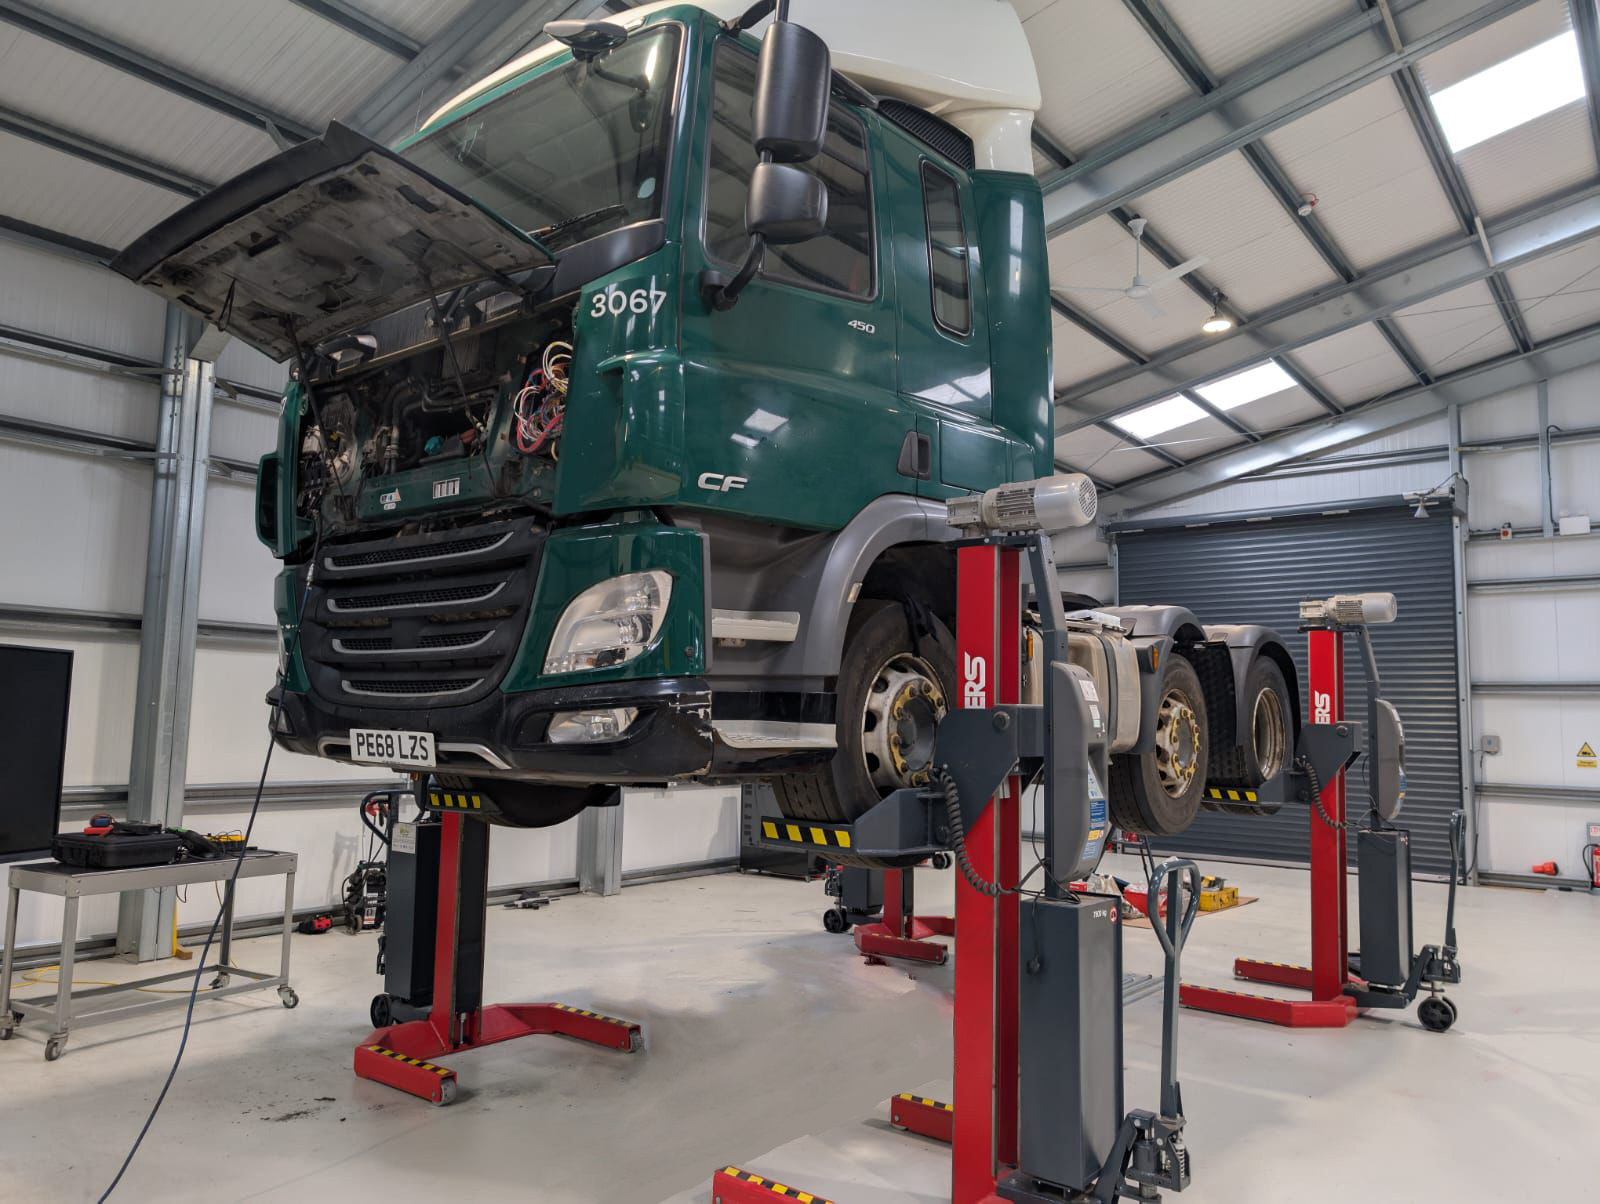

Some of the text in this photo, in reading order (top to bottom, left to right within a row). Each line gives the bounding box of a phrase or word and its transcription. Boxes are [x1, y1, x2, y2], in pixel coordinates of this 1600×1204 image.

[590, 288, 667, 318] 3067
[847, 319, 876, 334] 450
[698, 472, 748, 492] CF
[356, 732, 429, 760] PE68 LZS
